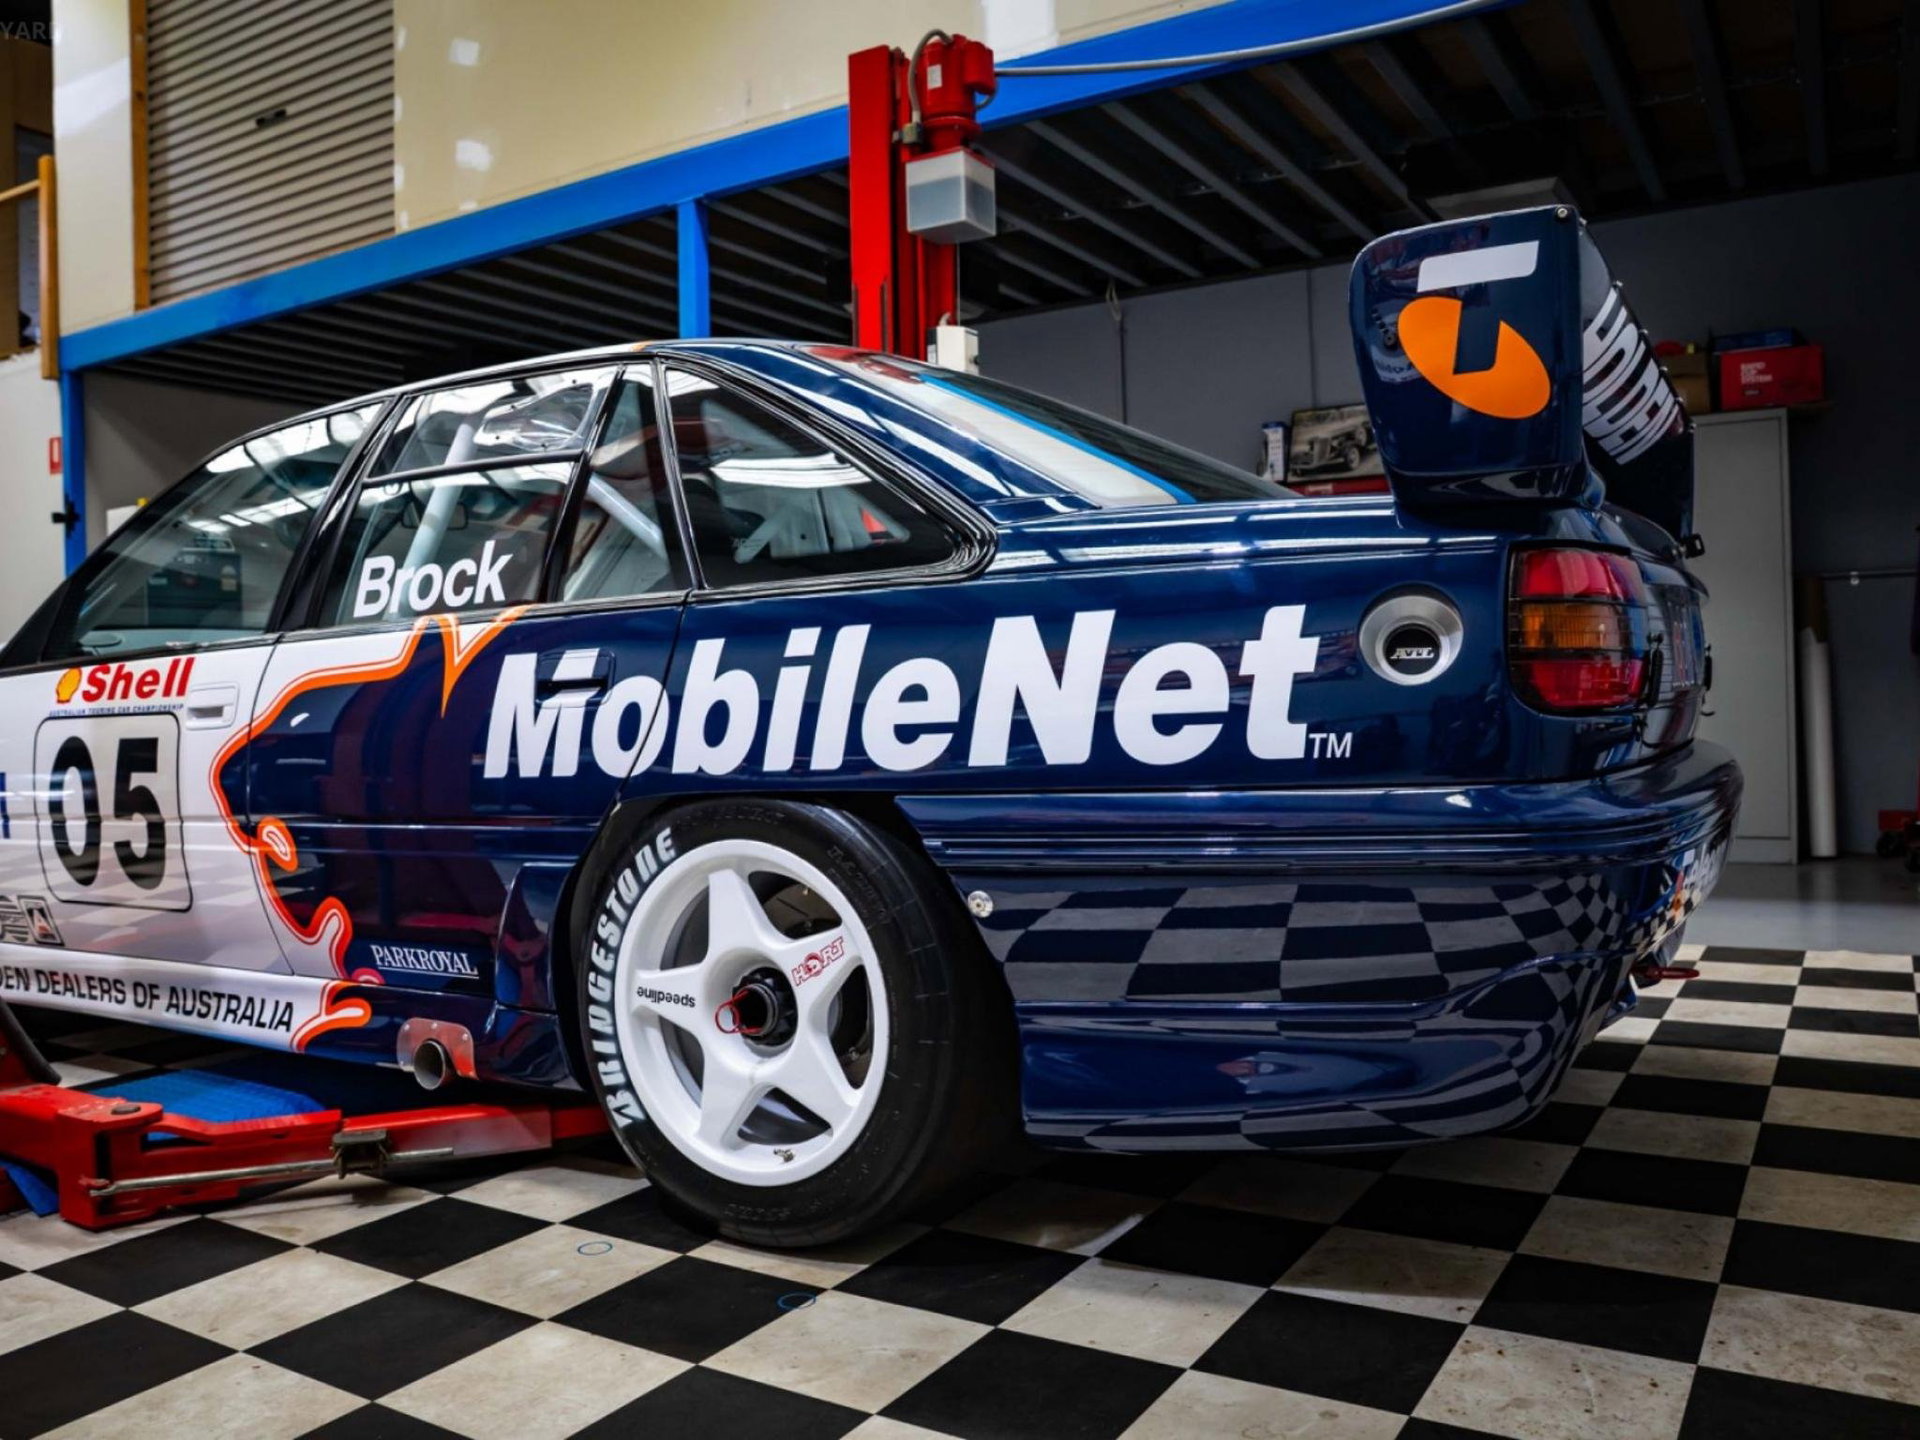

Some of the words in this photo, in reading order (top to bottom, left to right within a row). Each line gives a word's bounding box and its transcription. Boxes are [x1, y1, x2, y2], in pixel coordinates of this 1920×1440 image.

[1582, 286, 1680, 466] HOLDEN
[353, 540, 513, 618] Brock
[82, 657, 196, 703] Shell
[483, 604, 1320, 779] MobileNet
[1308, 732, 1353, 759] TM
[48, 735, 167, 890] 05
[370, 945, 479, 975] PARKROYAL
[588, 827, 678, 1129] BRIDGESTONE
[637, 986, 696, 1008] speedline
[34, 969, 126, 1004] DEALERS
[133, 982, 160, 1009] OF
[165, 985, 294, 1033] AUSTRALIA
